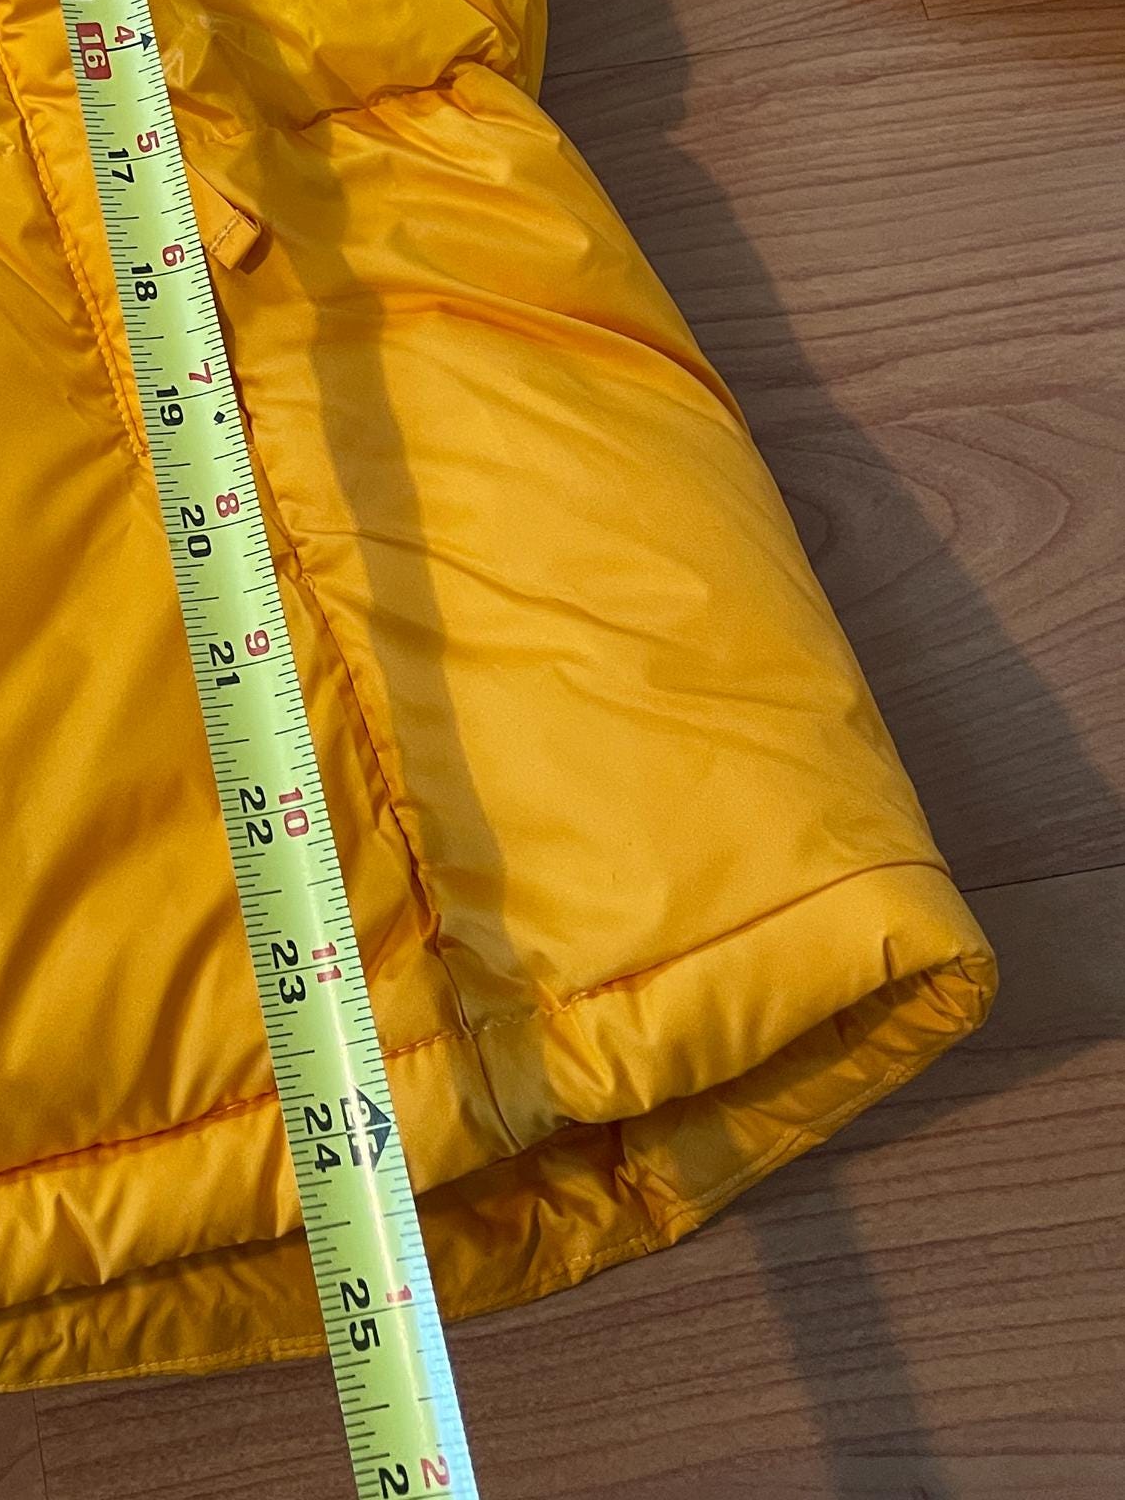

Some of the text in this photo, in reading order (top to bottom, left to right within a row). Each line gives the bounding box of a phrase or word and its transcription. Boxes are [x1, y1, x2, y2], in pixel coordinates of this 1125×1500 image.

[81, 33, 106, 69] 16
[114, 25, 136, 44] 4
[137, 130, 160, 153] 5
[108, 148, 135, 184] 17
[162, 244, 185, 267] 6
[131, 262, 158, 301] 18
[188, 362, 213, 384] 7
[156, 385, 184, 426] 19
[216, 492, 240, 518] 8
[180, 504, 212, 558] 20
[245, 629, 270, 657] 9
[209, 641, 241, 687] 21
[239, 785, 274, 847] 22
[278, 786, 310, 837] 10
[271, 939, 306, 1004] 23
[312, 942, 342, 983] 11
[303, 1103, 341, 1173] 24
[386, 1284, 413, 1303] 1
[340, 1278, 381, 1352] 25
[420, 1455, 450, 1488] 2
